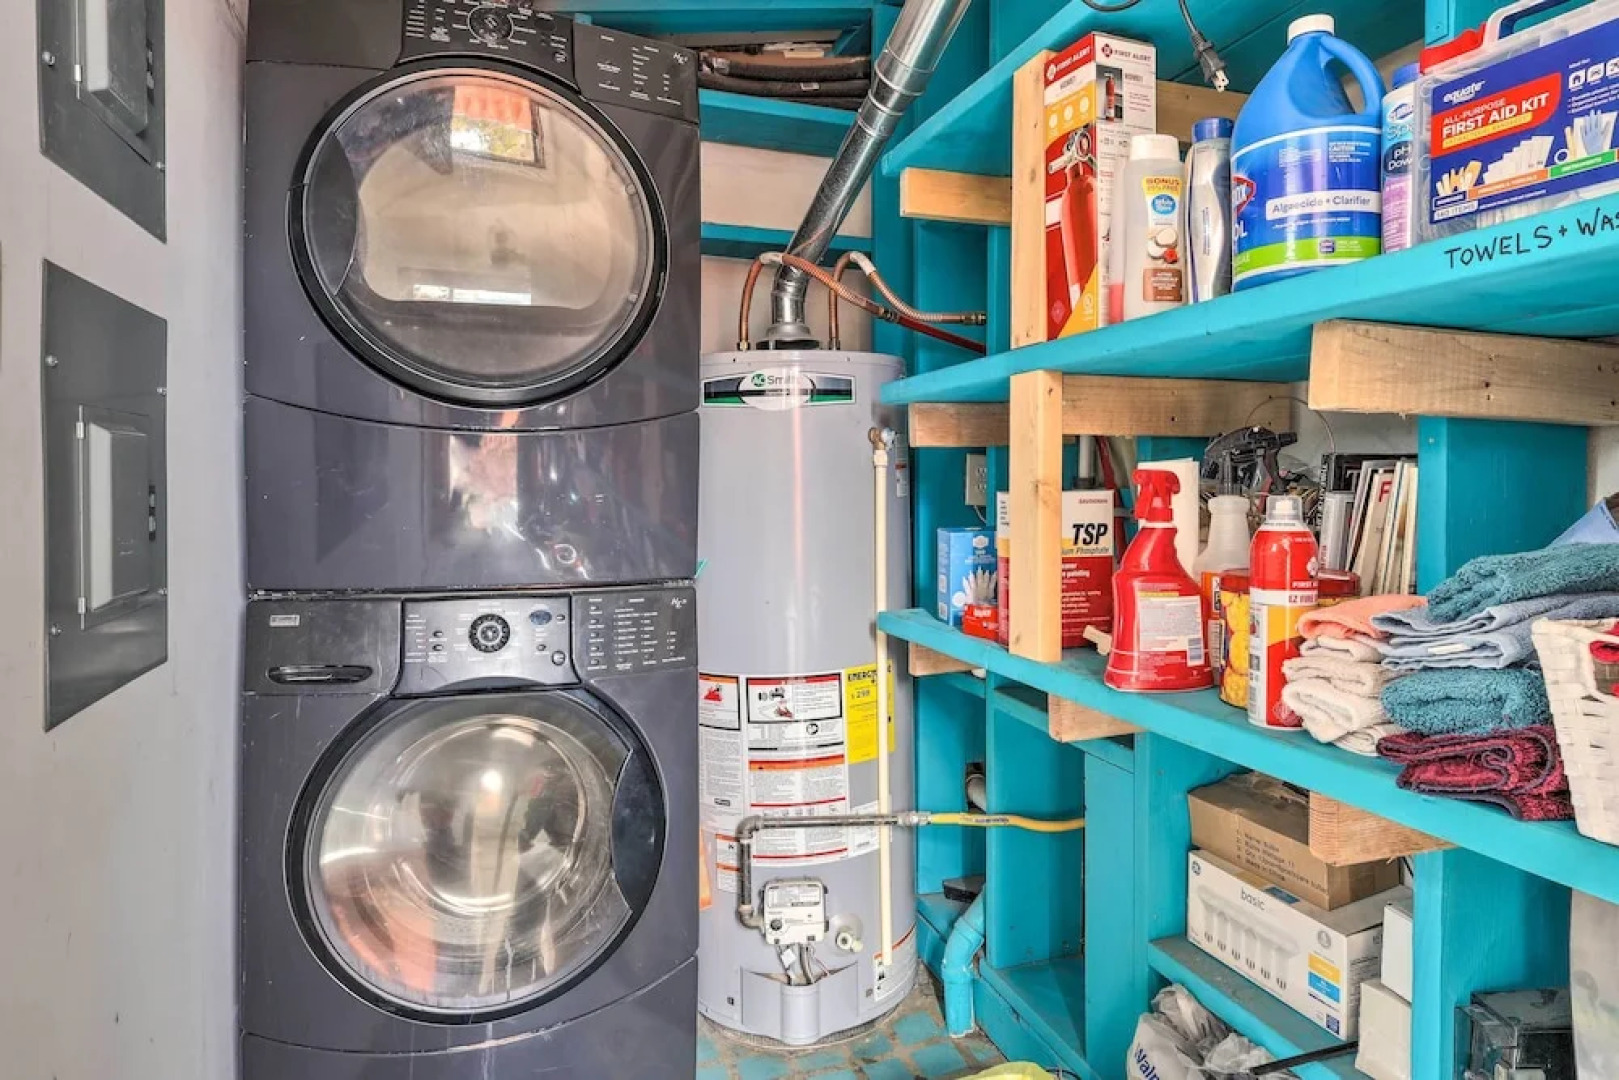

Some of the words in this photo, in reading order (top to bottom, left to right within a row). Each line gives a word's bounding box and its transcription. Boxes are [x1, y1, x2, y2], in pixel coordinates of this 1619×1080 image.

[1071, 45, 1091, 63] ALERT
[1113, 48, 1131, 58] FIRST
[1132, 52, 1152, 62] ALERT
[1442, 113, 1486, 139] FIRST
[1488, 104, 1518, 124] AID
[1521, 92, 1550, 113] KIT
[1443, 98, 1507, 125] ALL-PURPOSE
[1394, 144, 1412, 160] pH
[1388, 158, 1413, 171] Dow
[1145, 177, 1180, 186] BONUS
[1271, 197, 1324, 215] Algaecide
[1332, 194, 1371, 207] Clarifier
[1444, 225, 1553, 269] TOWELS
[1072, 522, 1108, 546] TSP
[1241, 887, 1265, 911] basic
